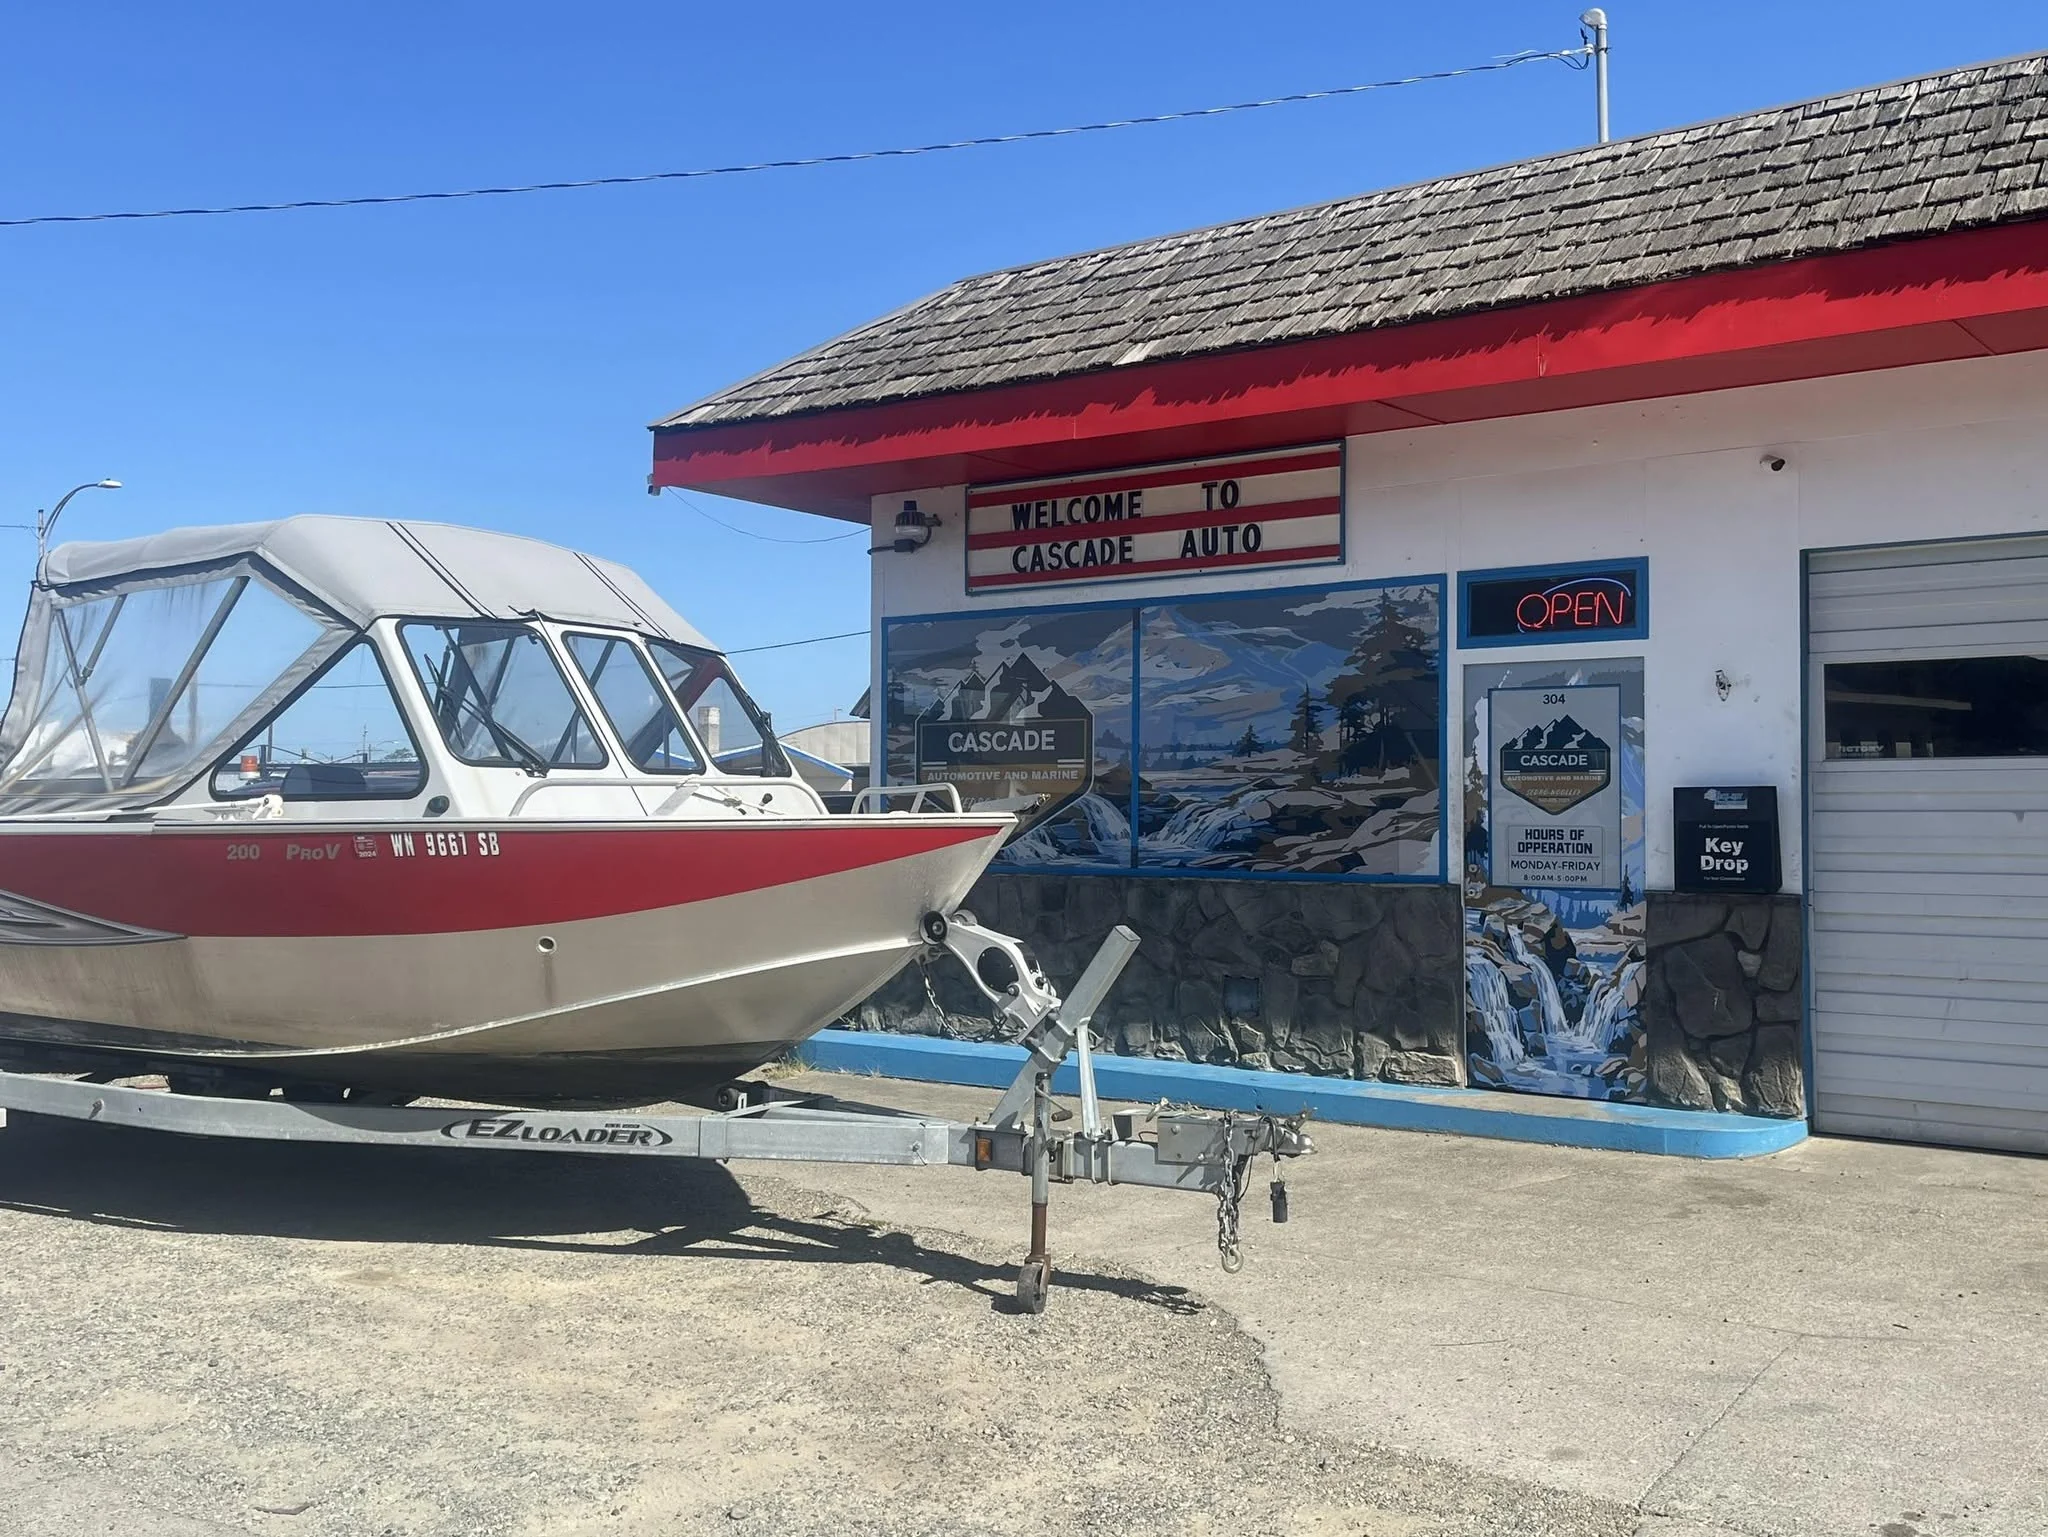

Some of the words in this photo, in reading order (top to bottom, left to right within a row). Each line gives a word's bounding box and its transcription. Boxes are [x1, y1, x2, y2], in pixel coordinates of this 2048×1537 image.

[1012, 491, 1143, 530] WELCOME
[1202, 480, 1240, 511] TO
[1012, 536, 1133, 573] CASCADE
[1181, 523, 1262, 558] AUTO
[1516, 591, 1625, 629] OPEN
[1542, 694, 1566, 705] 304
[948, 730, 1056, 753] CASCADE
[1520, 754, 1588, 766] CASCADE
[927, 771, 1000, 782] AUTOMOTIVE
[1004, 770, 1028, 780] AND
[1032, 769, 1079, 780] MARINE
[1525, 829, 1564, 840] HOURS
[1570, 829, 1585, 841] OF
[226, 844, 260, 860] 200
[390, 833, 415, 857] WN
[477, 832, 500, 856] SB
[1517, 842, 1593, 854] OPPERATION
[1705, 837, 1744, 856] Key
[1511, 860, 1601, 871] MONDAY-FRIDAY
[1700, 855, 1749, 874] Drop
